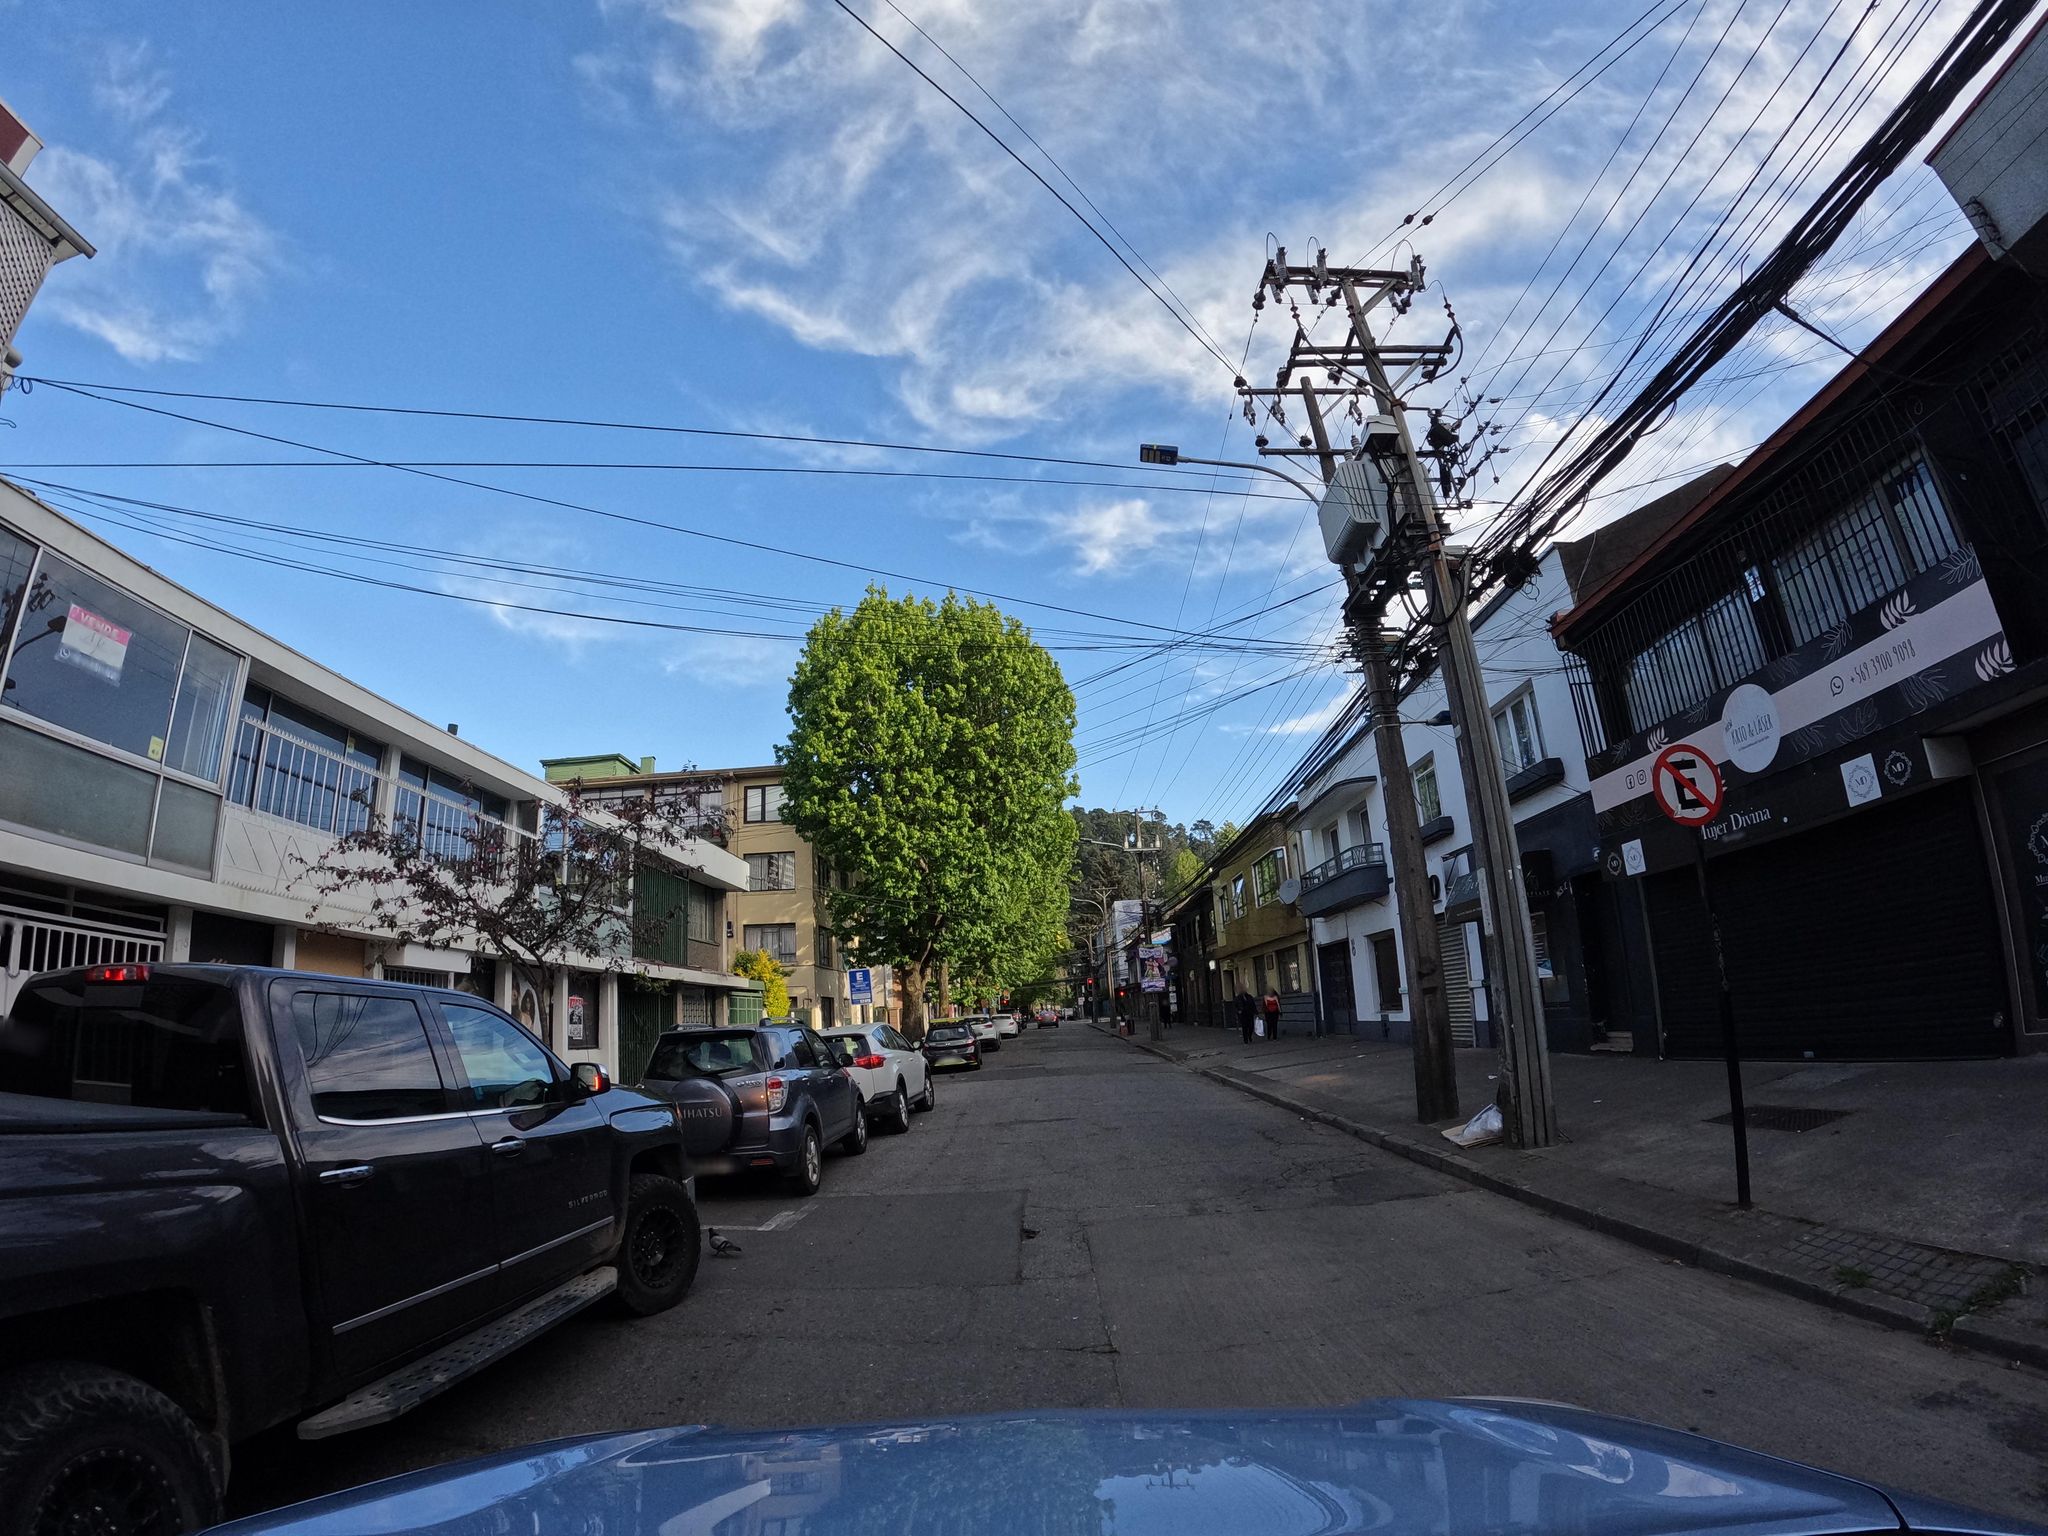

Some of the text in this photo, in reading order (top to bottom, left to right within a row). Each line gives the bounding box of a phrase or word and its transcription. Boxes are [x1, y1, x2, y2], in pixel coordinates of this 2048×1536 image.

[1870, 651, 1893, 676] 3900
[1892, 638, 1916, 664] 9098
[1669, 759, 1705, 809] E
[1729, 807, 1772, 831] Divina
[856, 972, 864, 981] E
[683, 1107, 722, 1119] IHATSU
